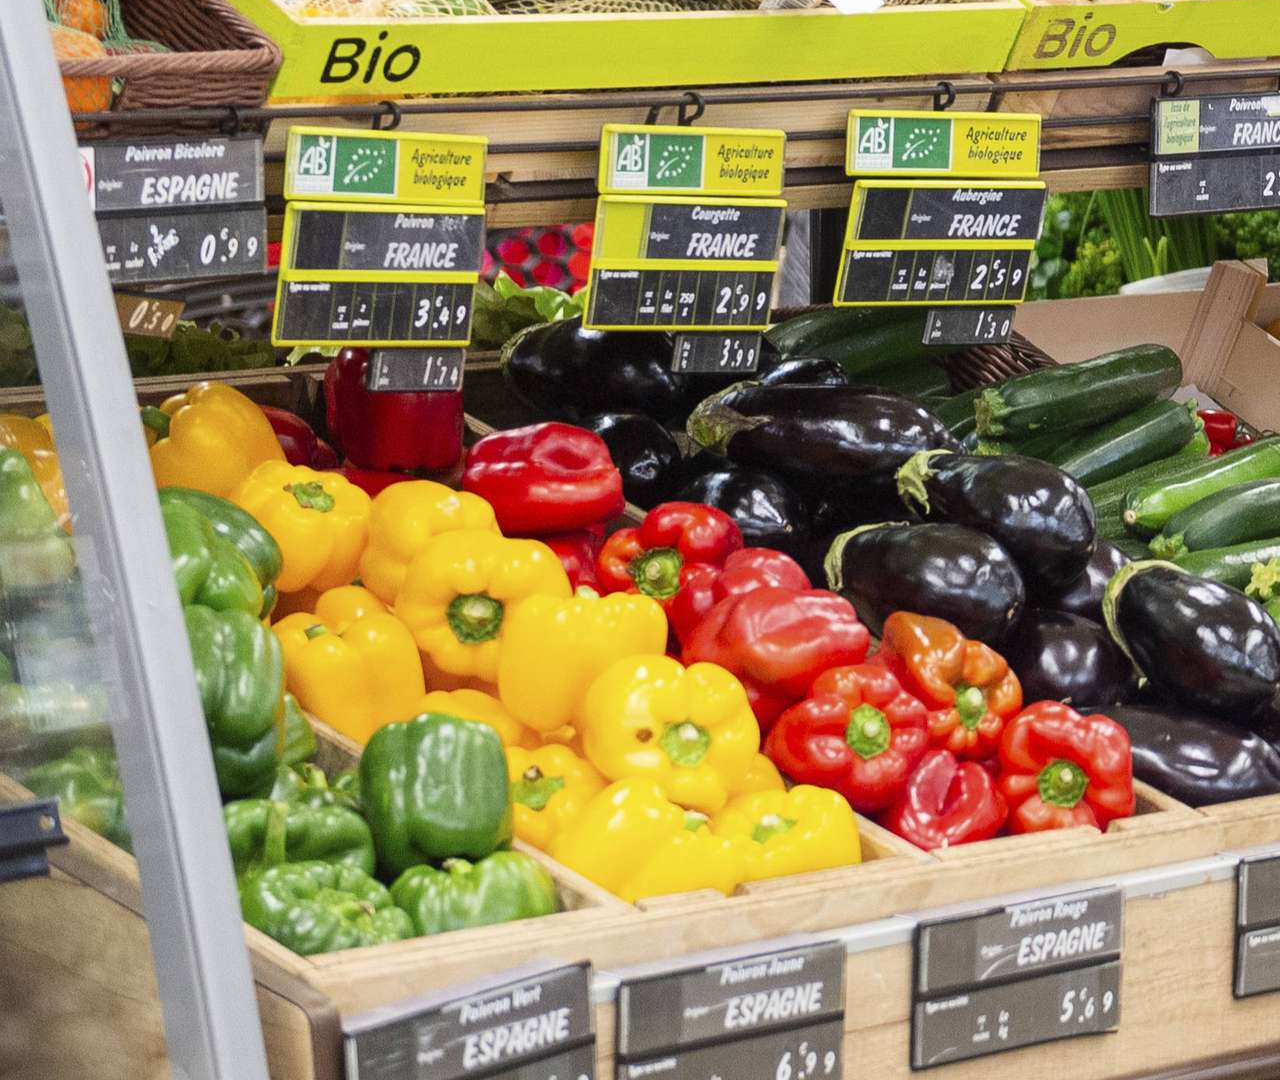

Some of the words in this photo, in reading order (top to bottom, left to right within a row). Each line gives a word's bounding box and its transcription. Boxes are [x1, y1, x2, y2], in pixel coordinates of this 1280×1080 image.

[1032, 10, 1117, 60] Bio
[320, 31, 421, 84] Bio
[1229, 98, 1262, 112] Poivron
[966, 126, 1027, 143] Agriculture
[125, 145, 172, 163] Poivron
[174, 142, 226, 159] Bicolore
[411, 149, 472, 168] Agriculture
[718, 144, 775, 162] Agriculture
[968, 146, 1023, 164] biologique
[412, 172, 468, 191] biologique
[720, 165, 770, 183] biologique
[141, 172, 240, 205] ESPAGNE
[952, 188, 1003, 205] Aubergine
[394, 214, 434, 229] Poivron
[692, 206, 740, 224] Courgette
[948, 214, 1021, 237] FRANCE
[384, 242, 459, 269] FRANCE
[687, 233, 759, 258] FRANCE
[1008, 902, 1053, 928] Poivron
[1053, 898, 1088, 920] Rouge
[1016, 921, 1107, 966] ESPAGNE
[512, 984, 543, 1009] Vert
[724, 981, 824, 1029] ESPAGNE
[463, 1007, 572, 1070] ESPAGNE
